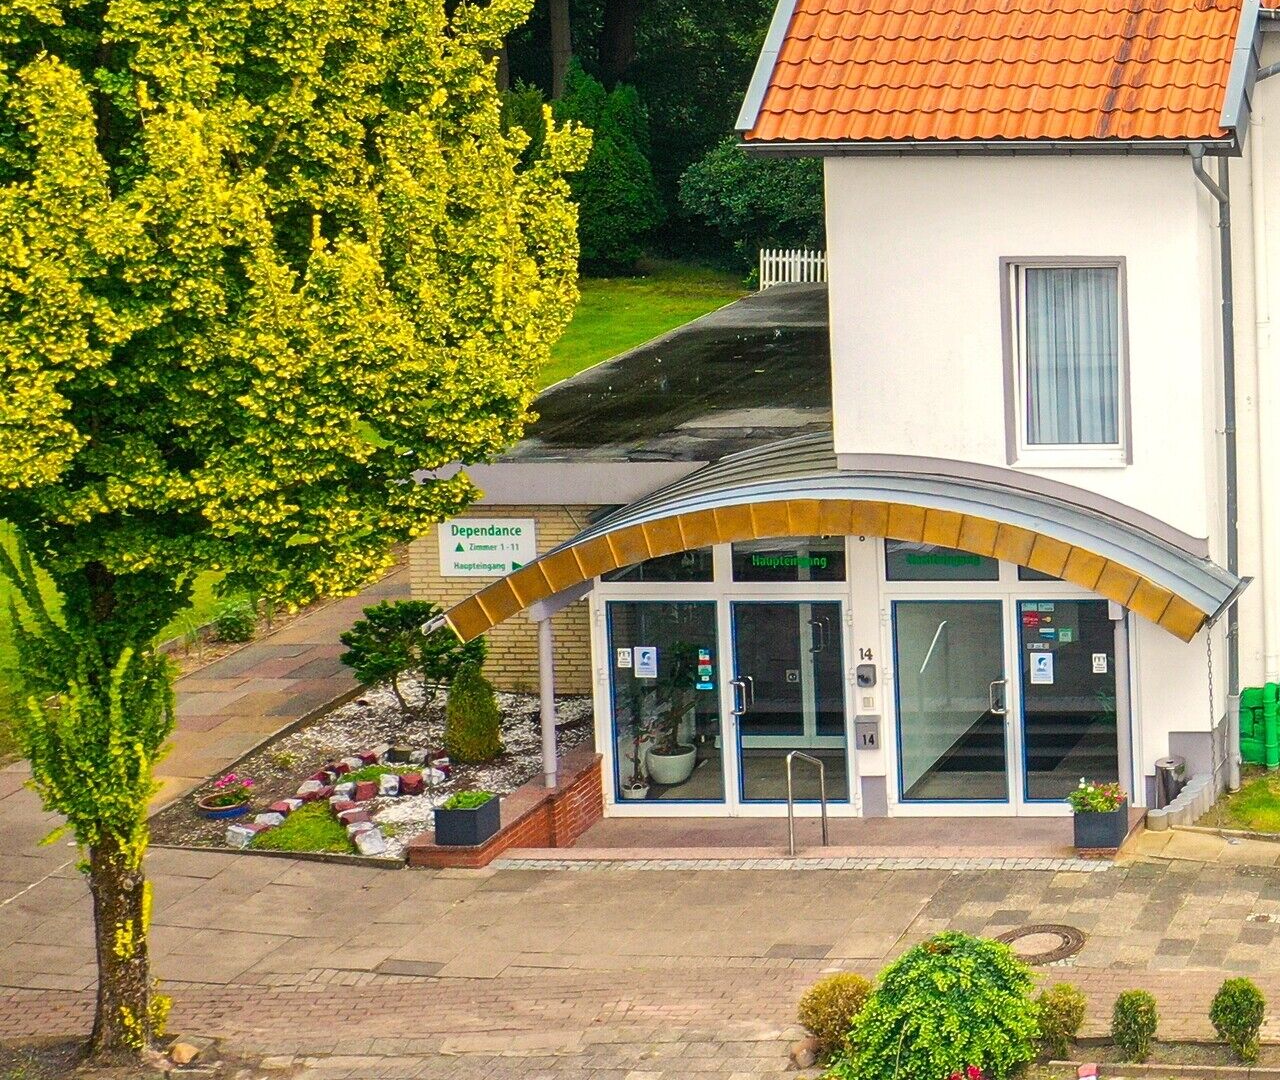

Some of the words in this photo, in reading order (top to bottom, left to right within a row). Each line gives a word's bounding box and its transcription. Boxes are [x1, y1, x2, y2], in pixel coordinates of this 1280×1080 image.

[451, 524, 522, 539] Dependance
[469, 543, 497, 551] Zimmer
[511, 543, 520, 551] 11
[453, 561, 506, 571] Haupteingang
[858, 647, 874, 661] 14
[862, 734, 875, 746] 14
